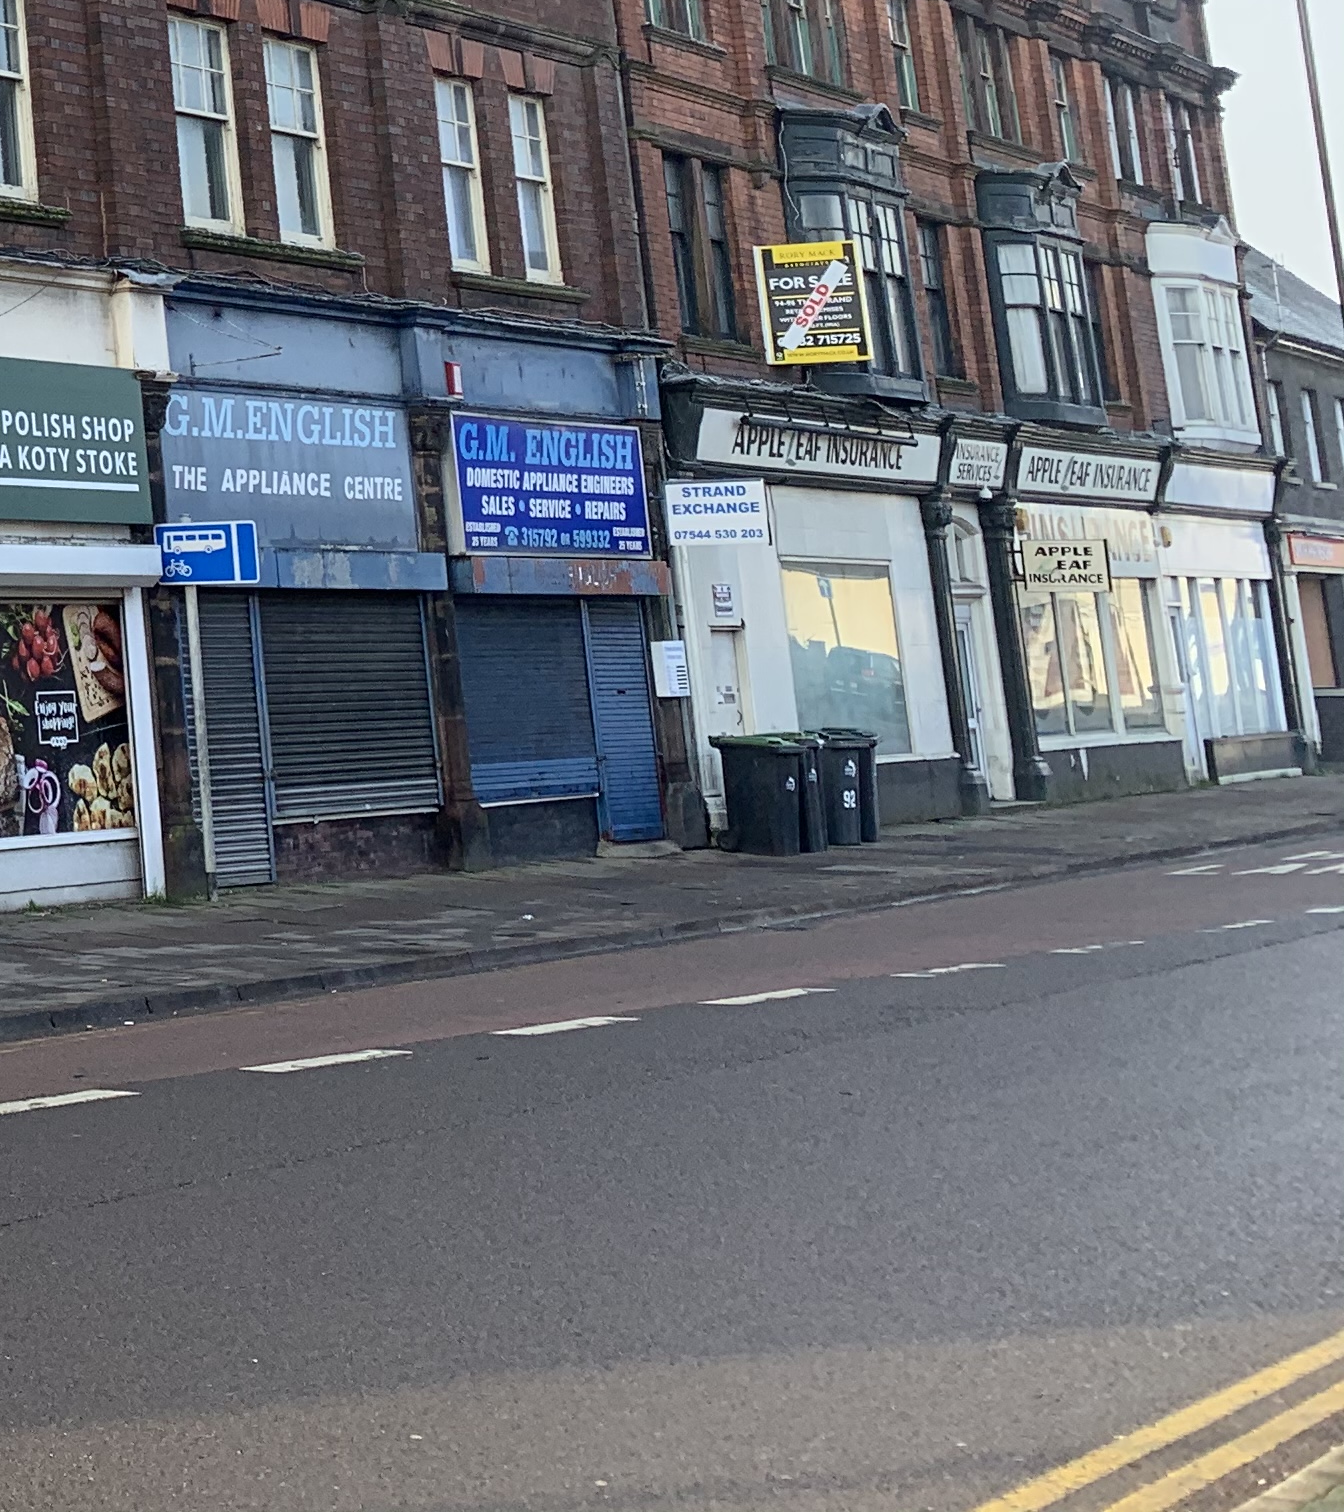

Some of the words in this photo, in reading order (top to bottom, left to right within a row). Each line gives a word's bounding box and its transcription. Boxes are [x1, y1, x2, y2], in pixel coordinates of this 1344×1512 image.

[779, 251, 805, 259] RORY
[808, 248, 836, 256] MACK
[769, 277, 806, 290] FOR
[795, 283, 830, 328] SOLD
[817, 333, 862, 345] 715725
[0, 409, 76, 439] POLISH
[81, 415, 134, 443] SHOP
[459, 422, 516, 463] G.M.
[524, 428, 634, 470] ENGLISH
[731, 424, 786, 458] APPLE
[826, 433, 903, 470] INSURANCE
[17, 445, 70, 472] KOTY
[75, 448, 138, 476] STOKE
[956, 462, 993, 482] SERVICES
[172, 464, 207, 492] THE
[220, 468, 332, 497] APPLIANCE
[344, 475, 403, 501] CENTRE
[466, 467, 520, 489] DOMESTIC
[522, 471, 579, 494] APPLIANCE
[580, 474, 634, 496] ENGINEERS
[1027, 454, 1063, 484] APPLE
[1092, 462, 1152, 493] INSURANCE
[681, 485, 746, 498] STRAND
[481, 495, 516, 516] SALES
[529, 498, 572, 519] SERVICE
[584, 500, 627, 521] REPAIRS
[672, 501, 760, 515] EXCHANGE
[520, 526, 558, 548] 315792
[572, 529, 611, 549] 599332
[674, 529, 711, 540] 07544
[714, 529, 737, 539] 530
[740, 528, 764, 538] 203
[1034, 546, 1093, 557] APPLE
[842, 789, 857, 809] 92
